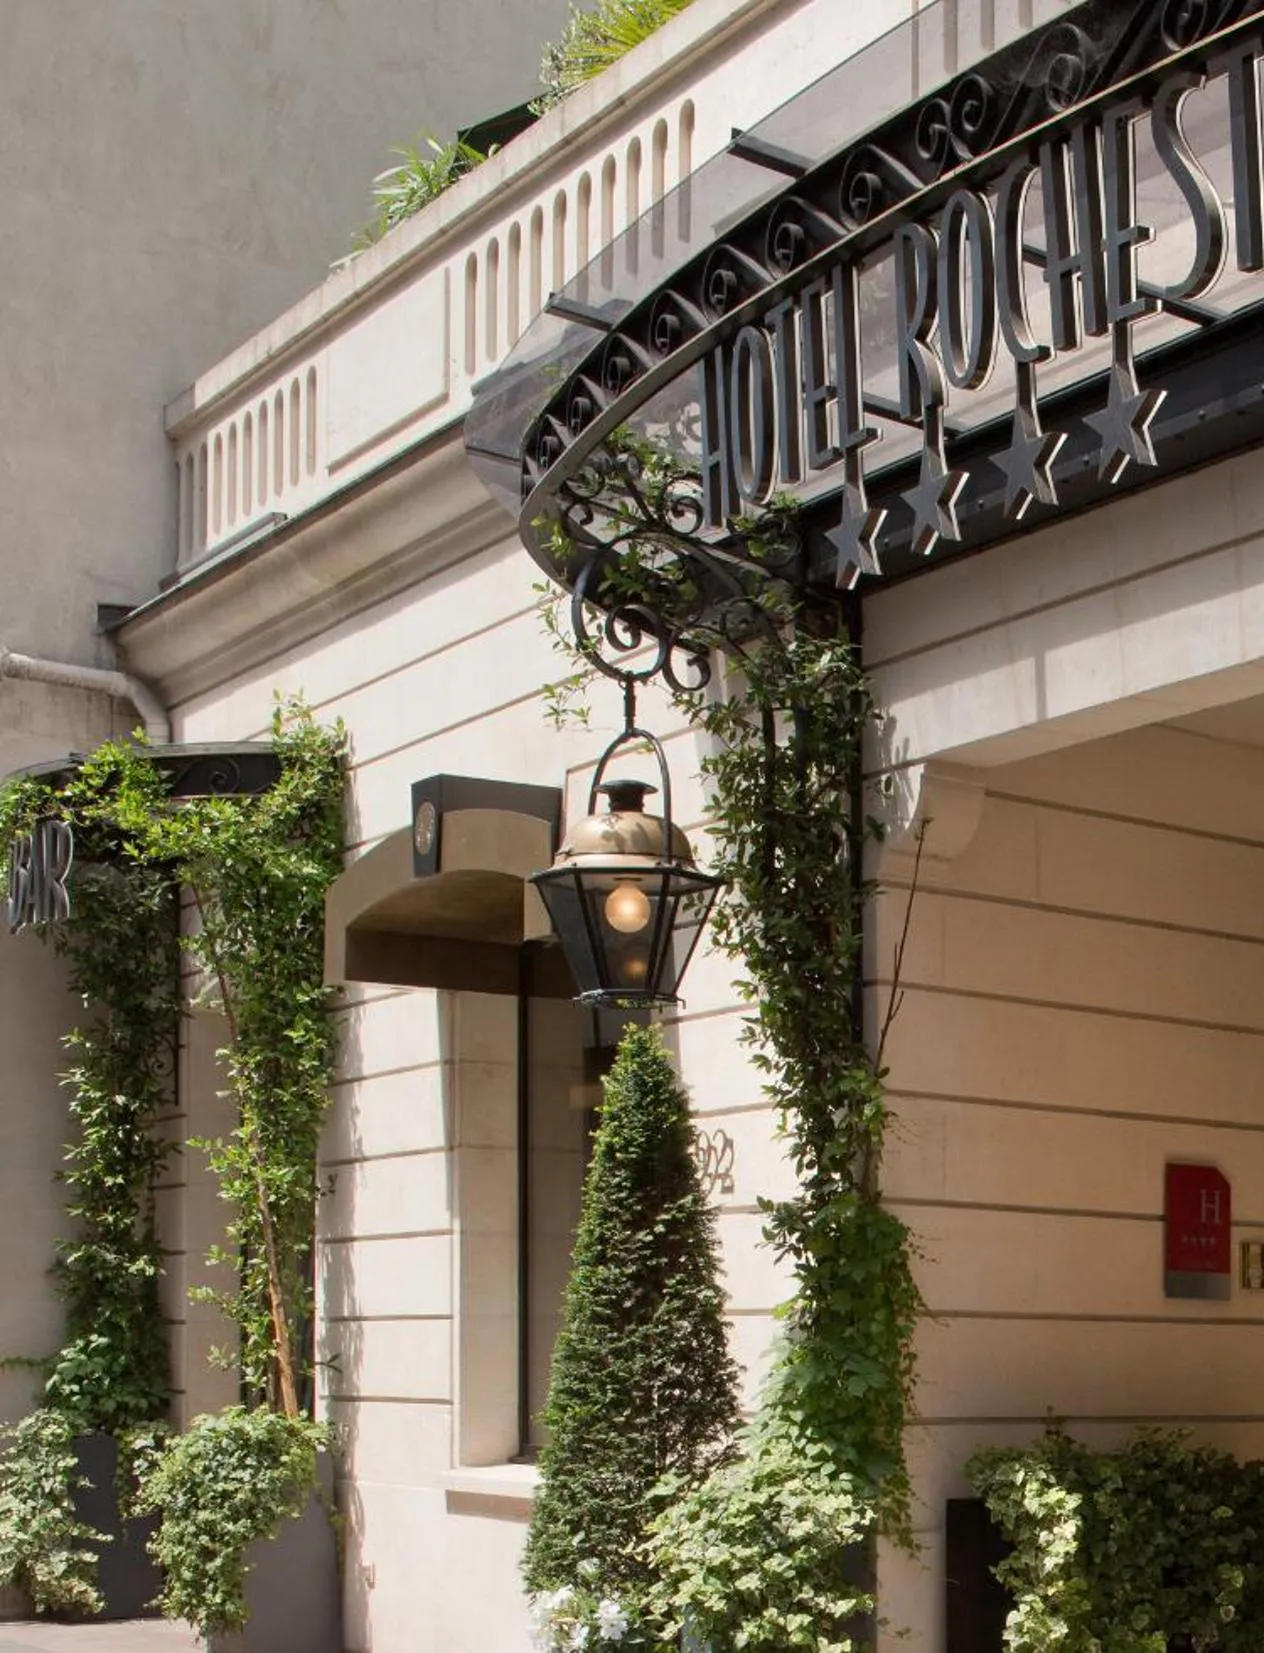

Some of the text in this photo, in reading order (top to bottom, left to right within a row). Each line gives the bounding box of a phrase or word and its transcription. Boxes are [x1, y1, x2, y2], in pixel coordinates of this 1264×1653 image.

[702, 263, 882, 530] HOTEL
[8, 819, 73, 934] BAR
[1200, 1188, 1222, 1224] H
